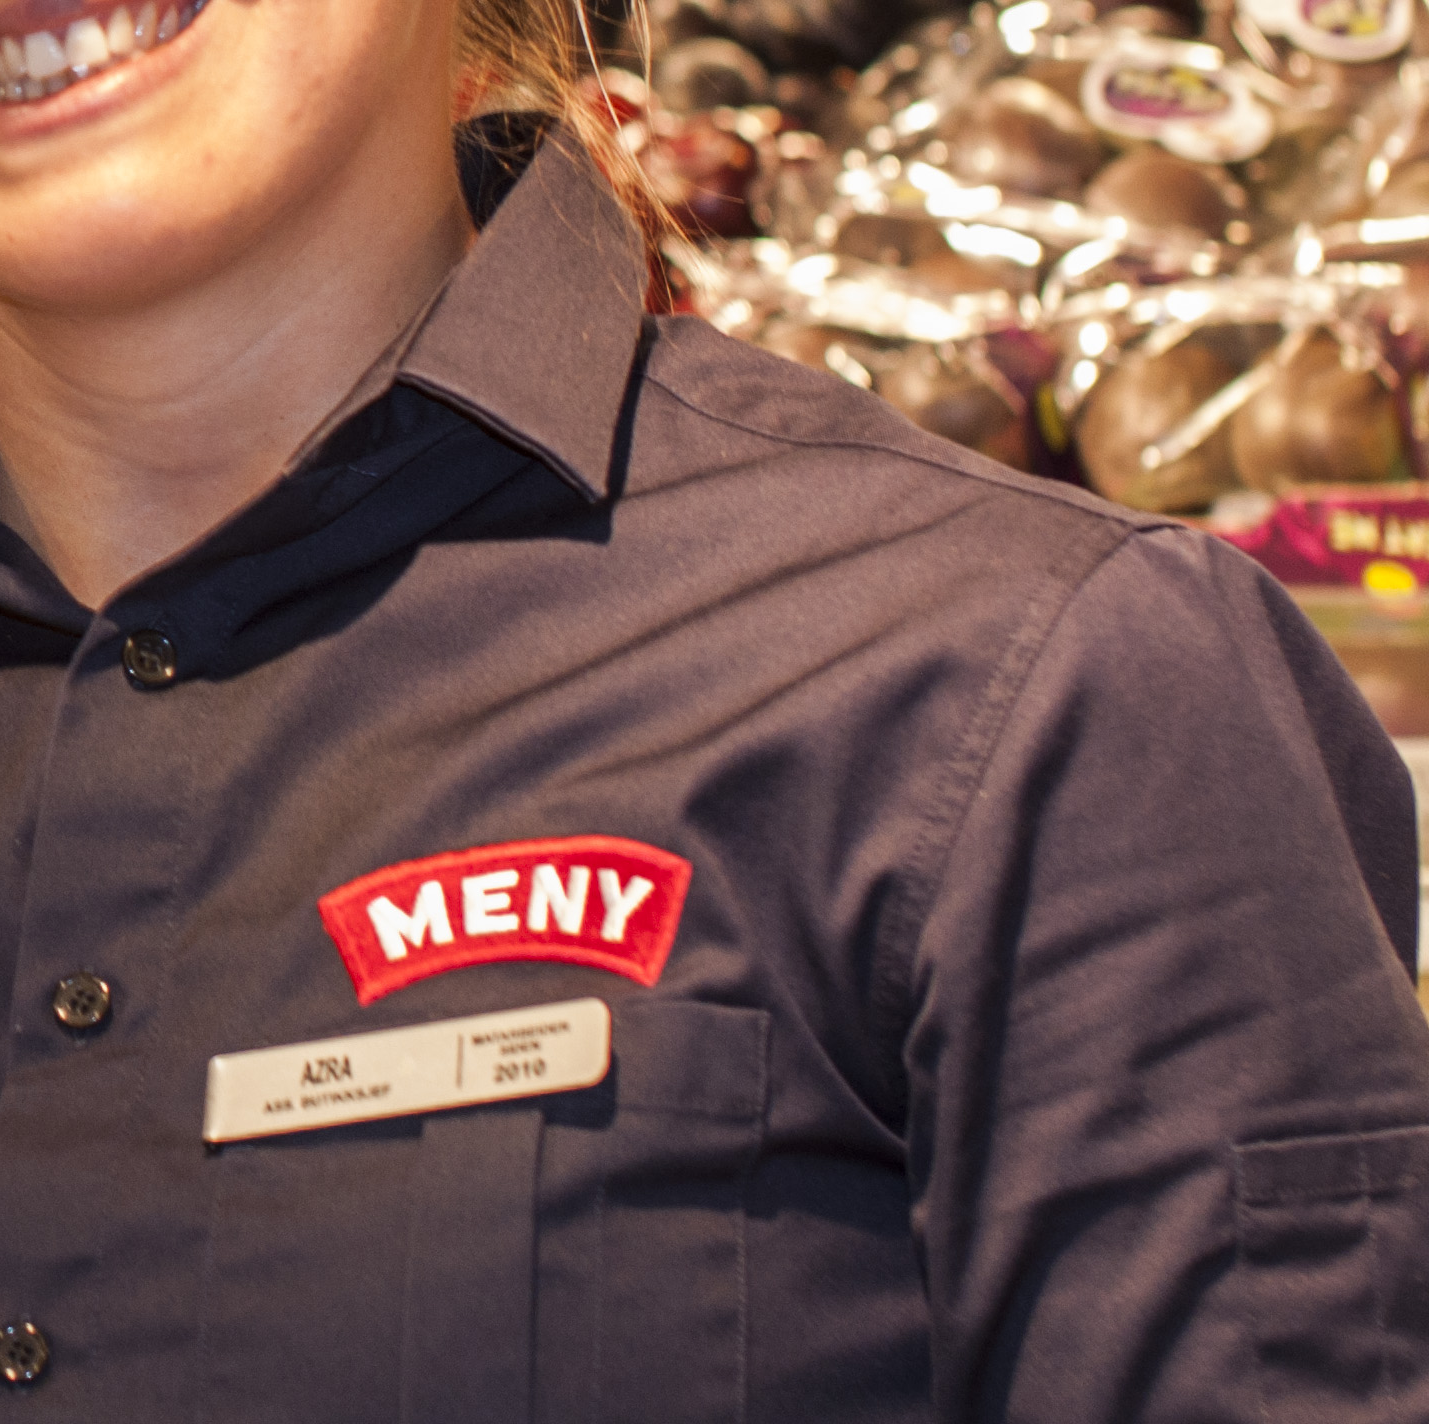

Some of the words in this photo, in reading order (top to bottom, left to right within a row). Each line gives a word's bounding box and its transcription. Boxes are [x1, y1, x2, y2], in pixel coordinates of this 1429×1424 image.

[367, 863, 655, 962] MENY
[301, 1055, 353, 1087] AZRA
[493, 1057, 547, 1083] 2010
